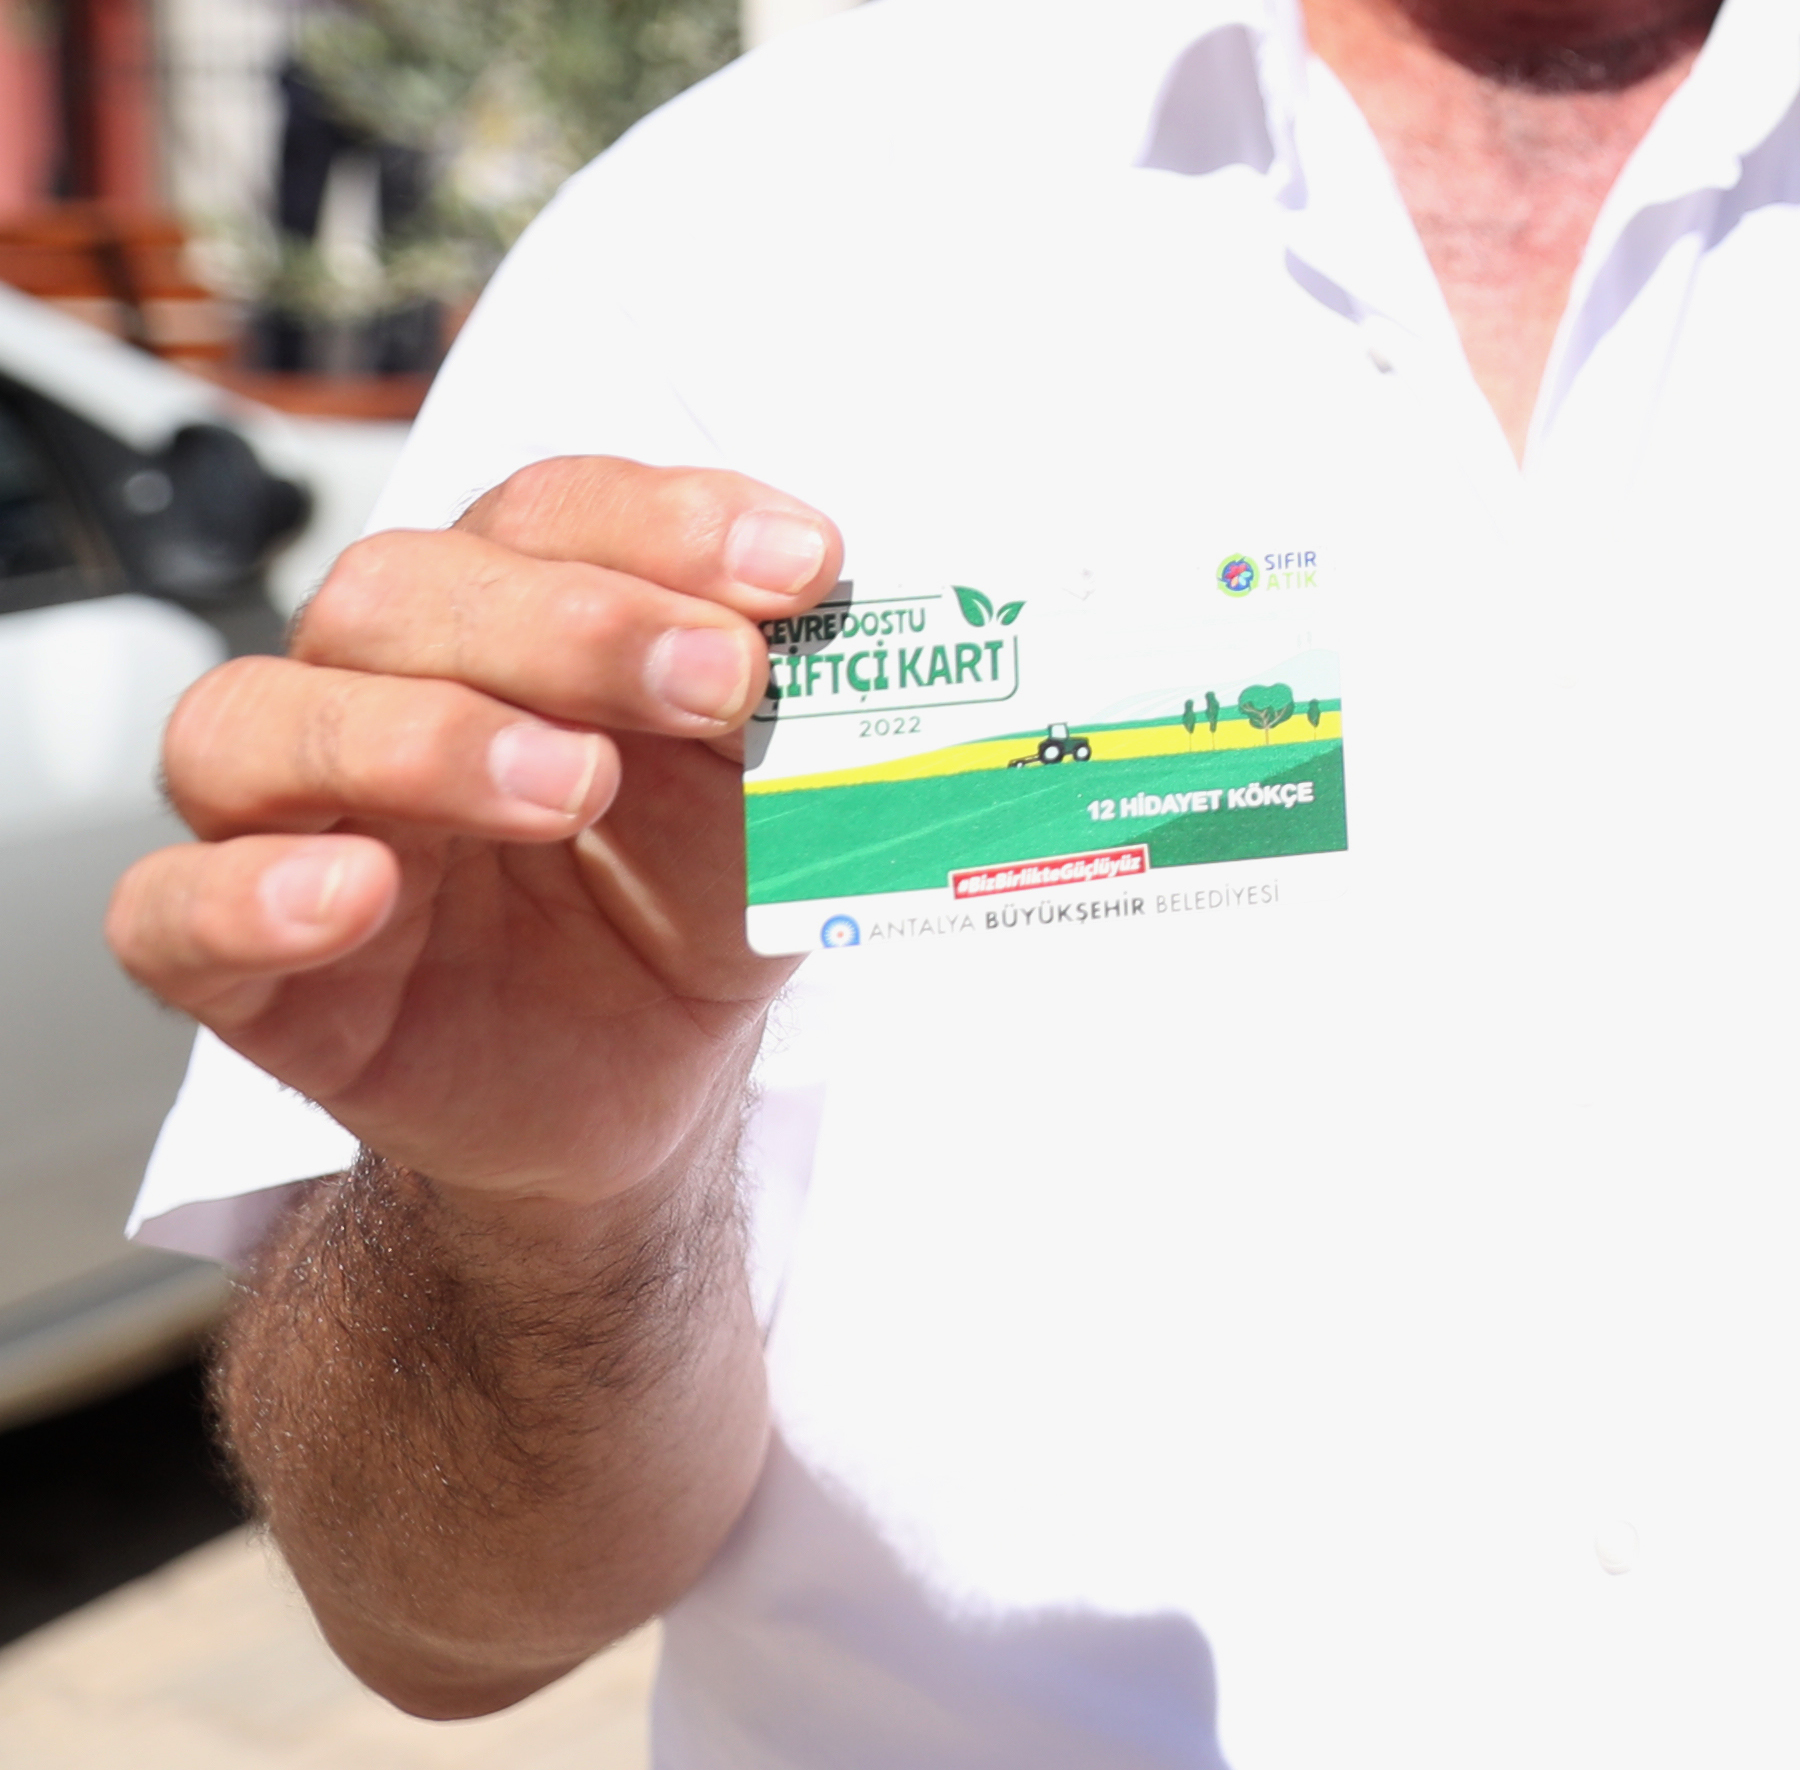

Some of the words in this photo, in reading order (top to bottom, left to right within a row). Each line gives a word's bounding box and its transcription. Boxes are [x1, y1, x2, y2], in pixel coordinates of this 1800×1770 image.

[1263, 550, 1318, 572] SIFIR
[1265, 570, 1319, 591] ATIK
[840, 606, 926, 638] DOSTU
[767, 639, 889, 711] ÇİFTÇİ
[898, 638, 1005, 690] KART
[859, 716, 922, 738] 2022
[1087, 799, 1116, 821] 12
[1119, 789, 1223, 819] HİDAYET
[1227, 781, 1315, 809] KÖKÇE
[957, 854, 1142, 894] #BizBirlikteGüçlüyüz
[868, 914, 976, 942] ANTALYA
[985, 891, 1147, 931] BÜYÜKŞEHİR
[1156, 879, 1281, 915] BELEDİYESİ
